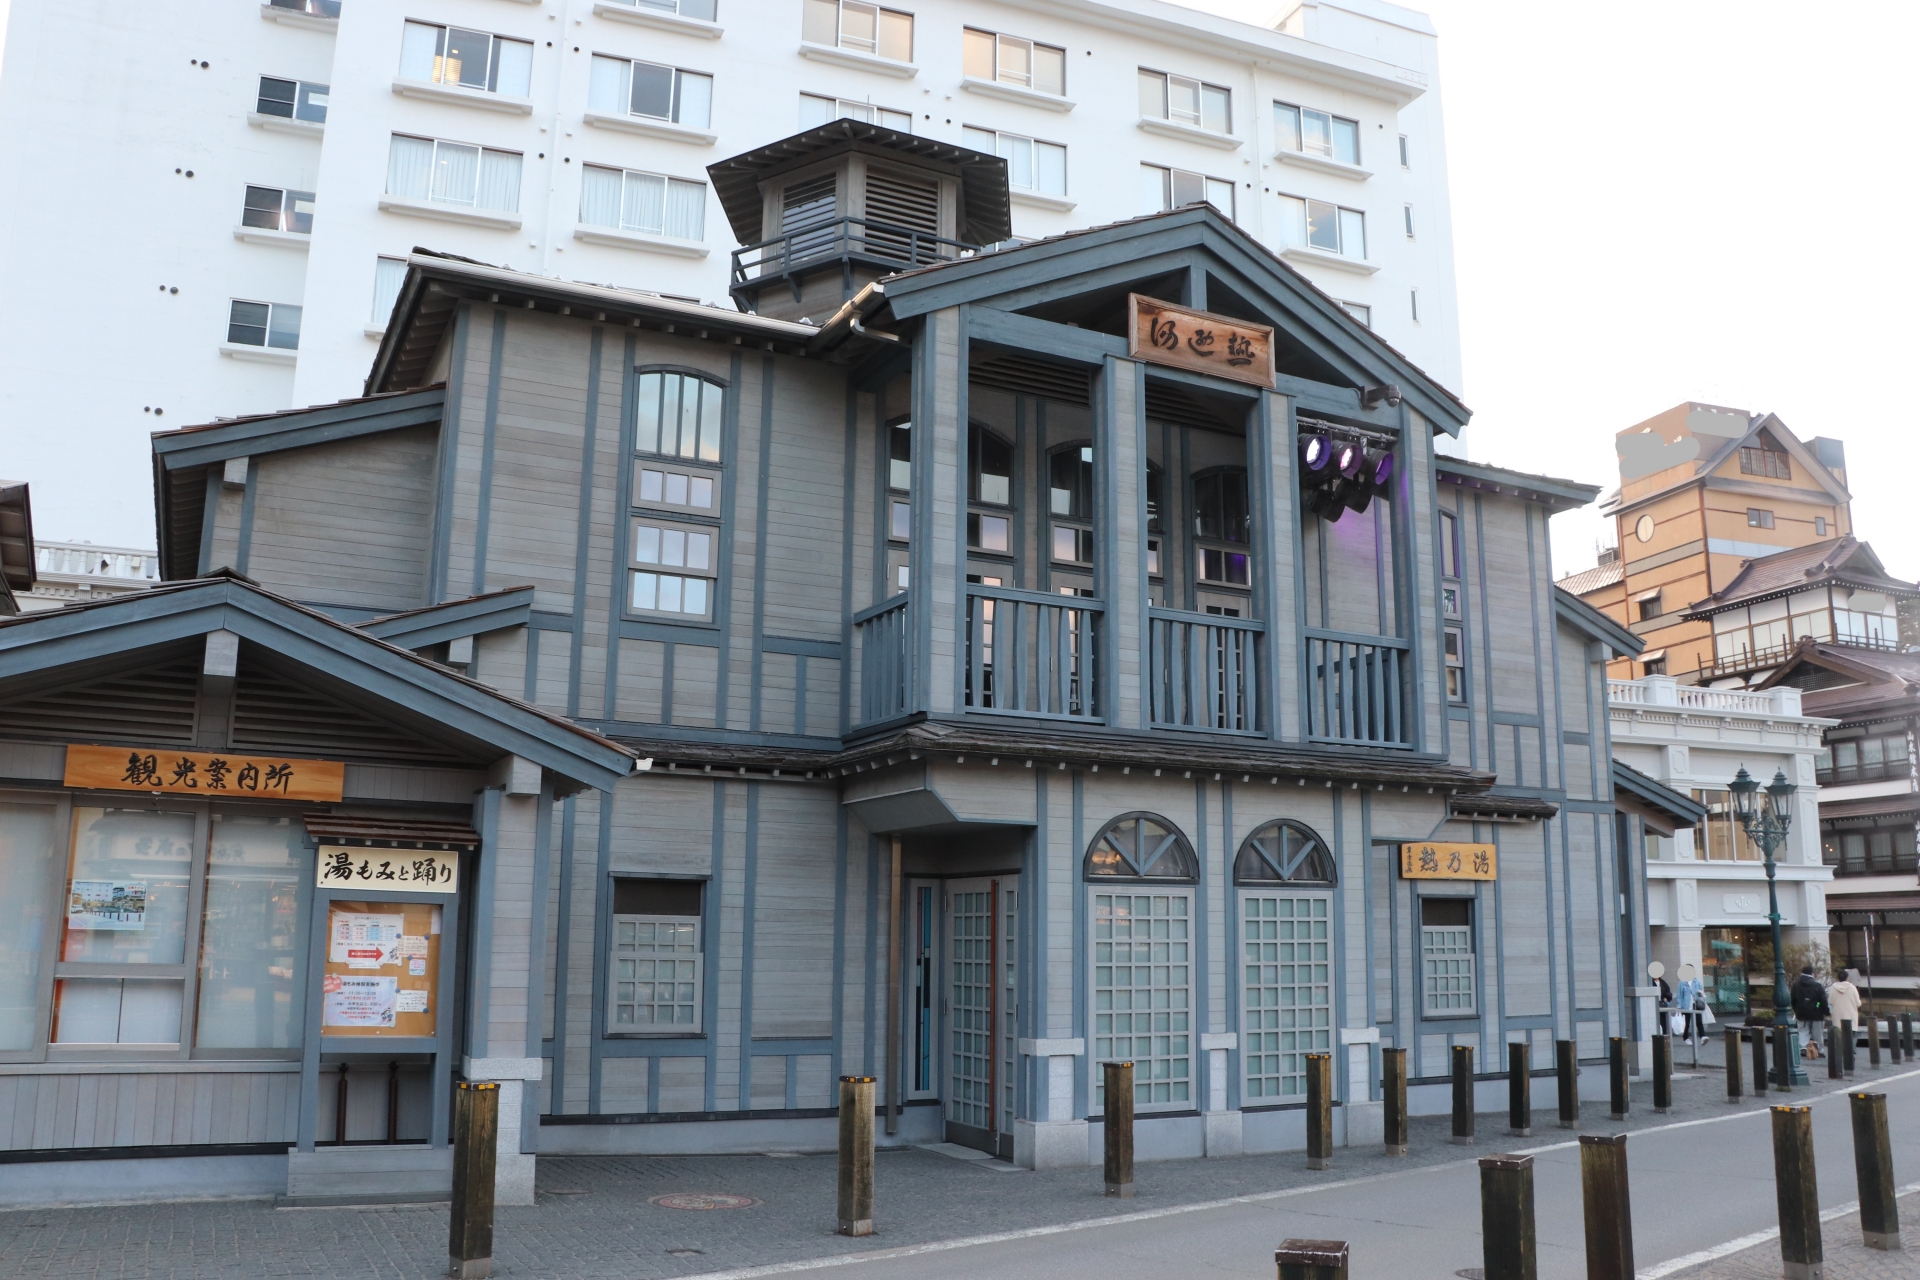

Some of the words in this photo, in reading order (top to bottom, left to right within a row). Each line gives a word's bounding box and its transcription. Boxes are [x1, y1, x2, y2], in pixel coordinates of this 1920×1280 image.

[121, 752, 294, 796] 観光案内所
[324, 852, 452, 886] 湯もみと踊り
